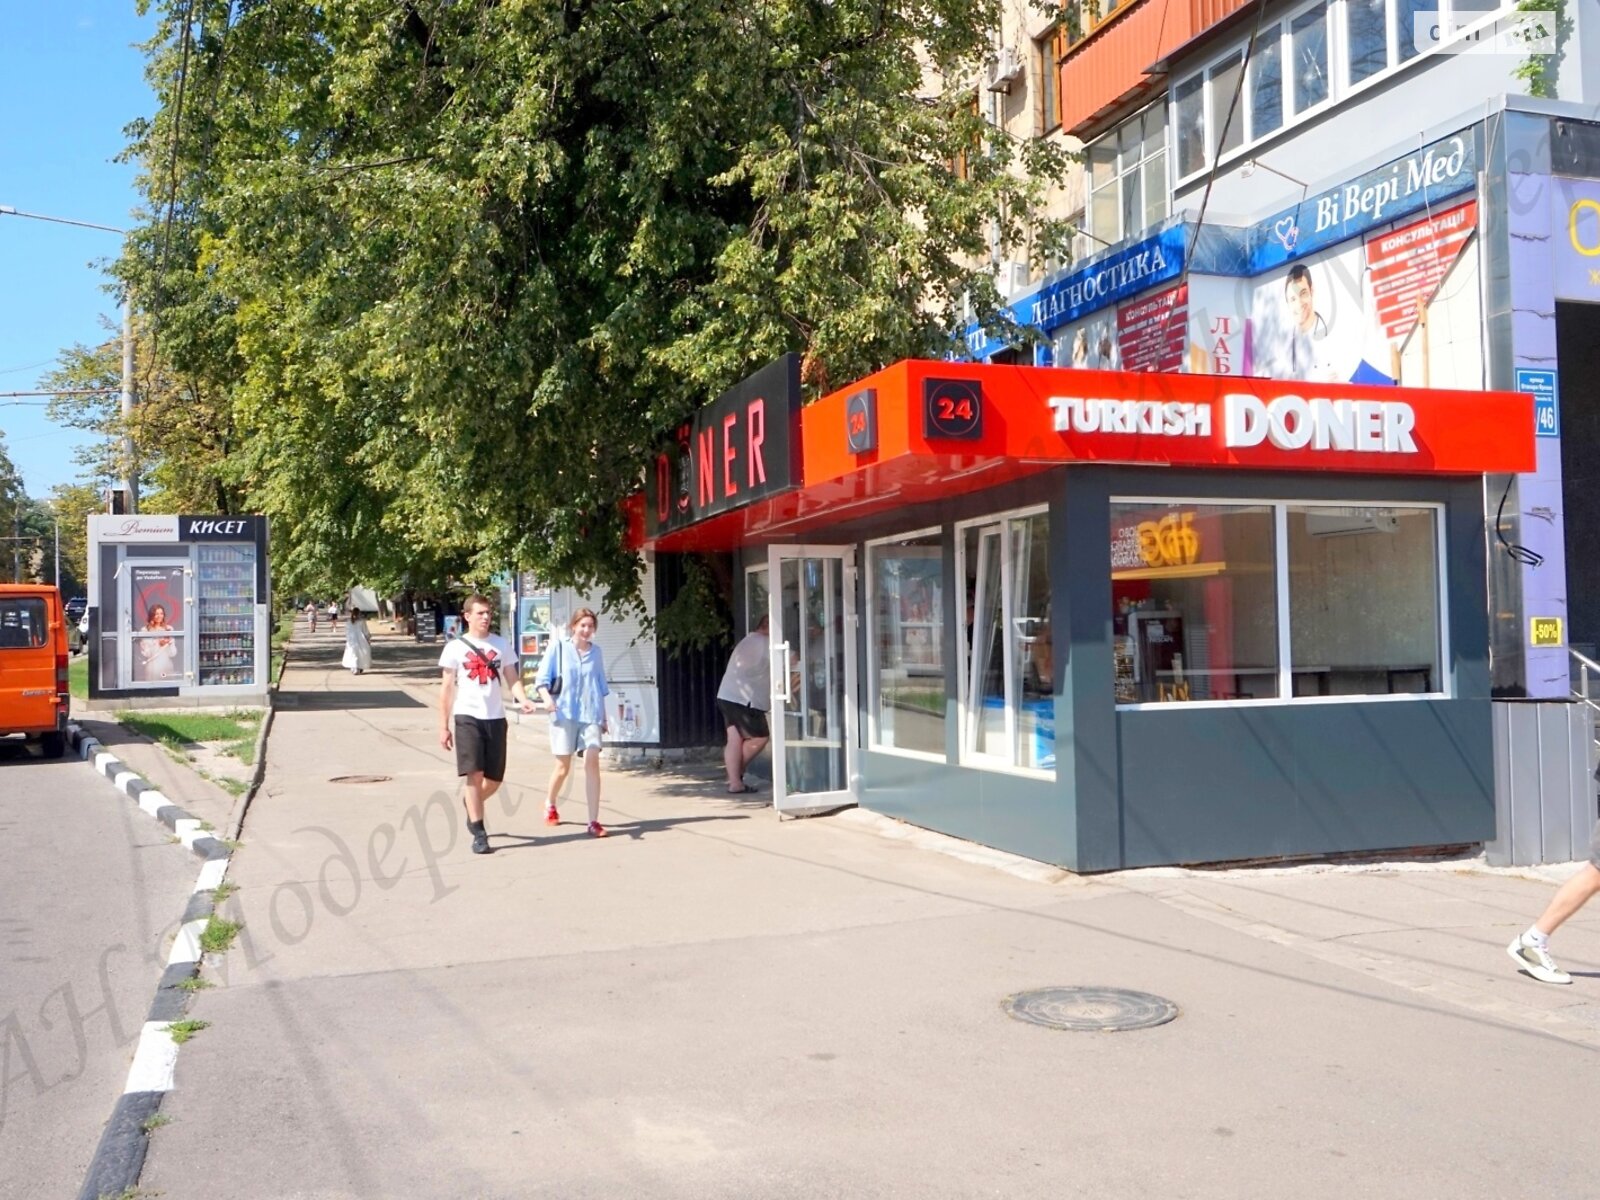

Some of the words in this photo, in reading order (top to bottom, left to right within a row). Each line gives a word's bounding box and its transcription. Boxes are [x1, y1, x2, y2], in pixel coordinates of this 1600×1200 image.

[1404, 137, 1464, 196] Мед
[1031, 246, 1167, 326] ДІАГНОСТИКА
[937, 398, 974, 420] 24
[852, 415, 867, 434] 24
[1049, 397, 1212, 437] TURKISH
[1224, 394, 1418, 453] DONER
[103, 519, 174, 536] Premium
[189, 520, 247, 534] КИСЕТ
